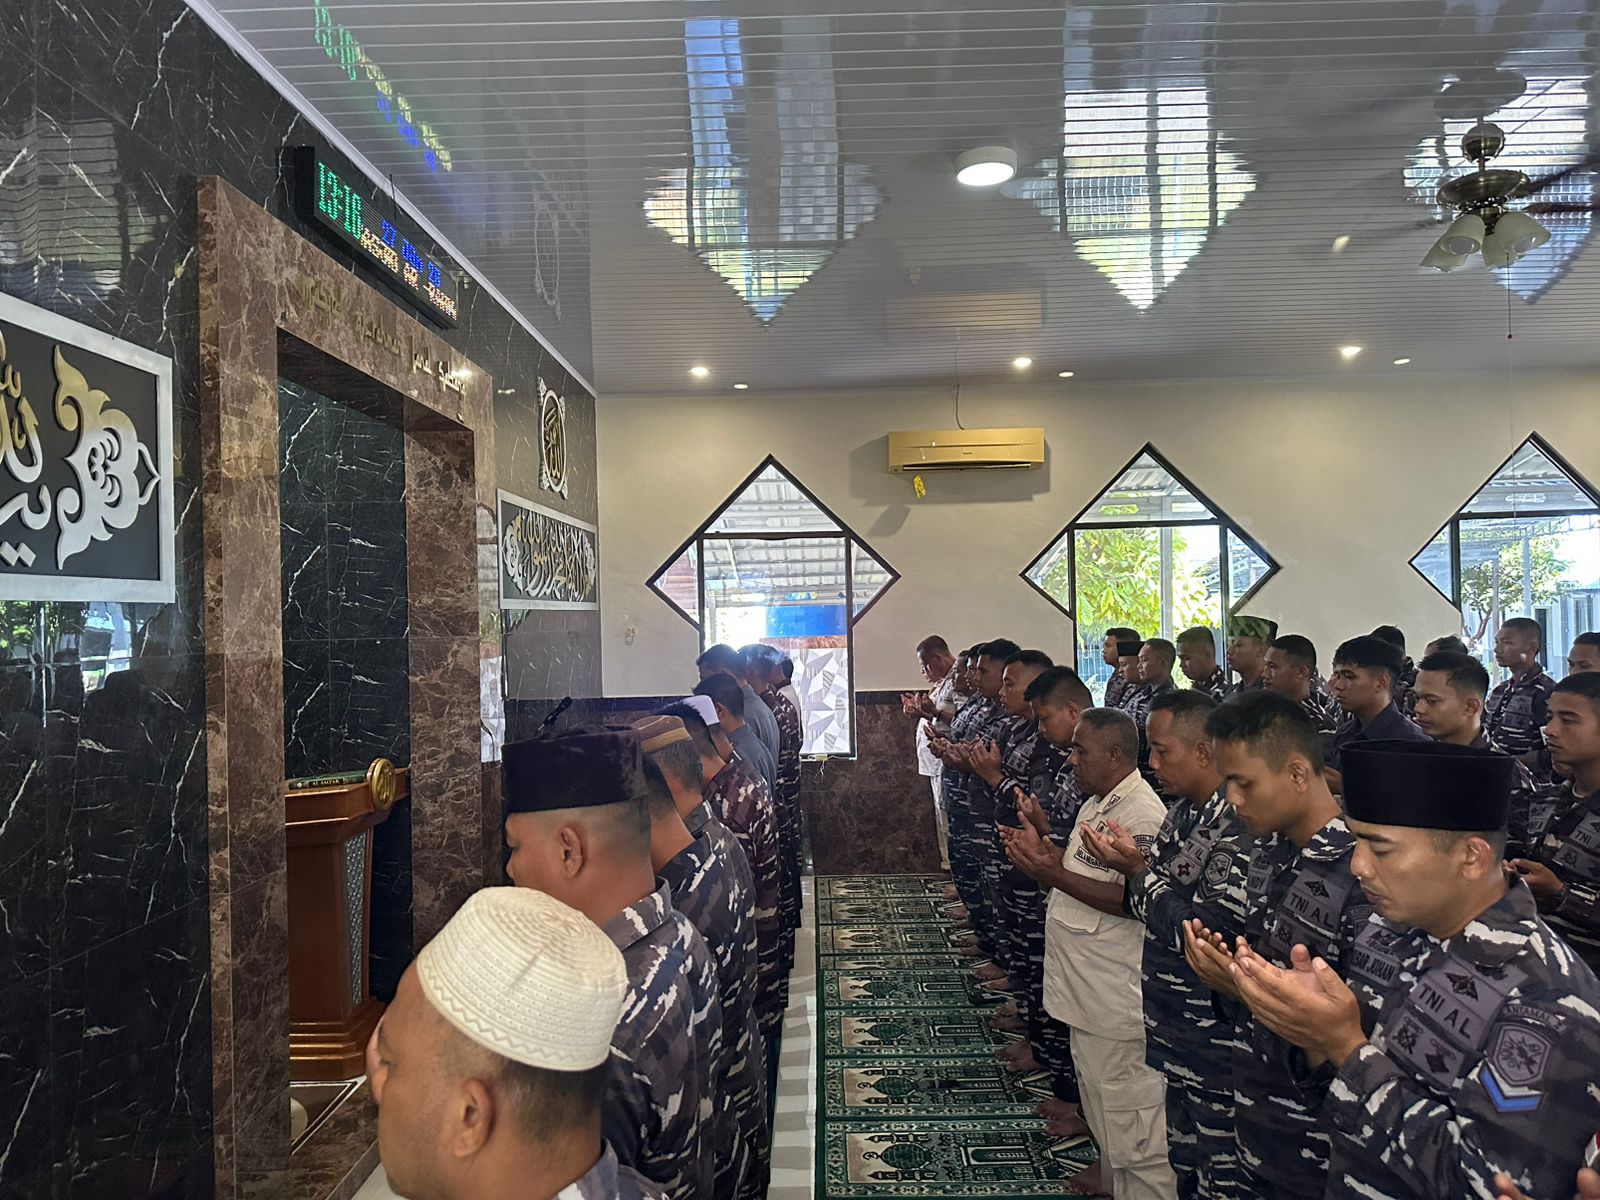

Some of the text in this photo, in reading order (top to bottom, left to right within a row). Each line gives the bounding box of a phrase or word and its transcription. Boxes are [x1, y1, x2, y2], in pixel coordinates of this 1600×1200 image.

[318, 162, 362, 239] 13:16
[1289, 892, 1335, 928] TNI AL
[1418, 983, 1471, 1039] TNI AL
